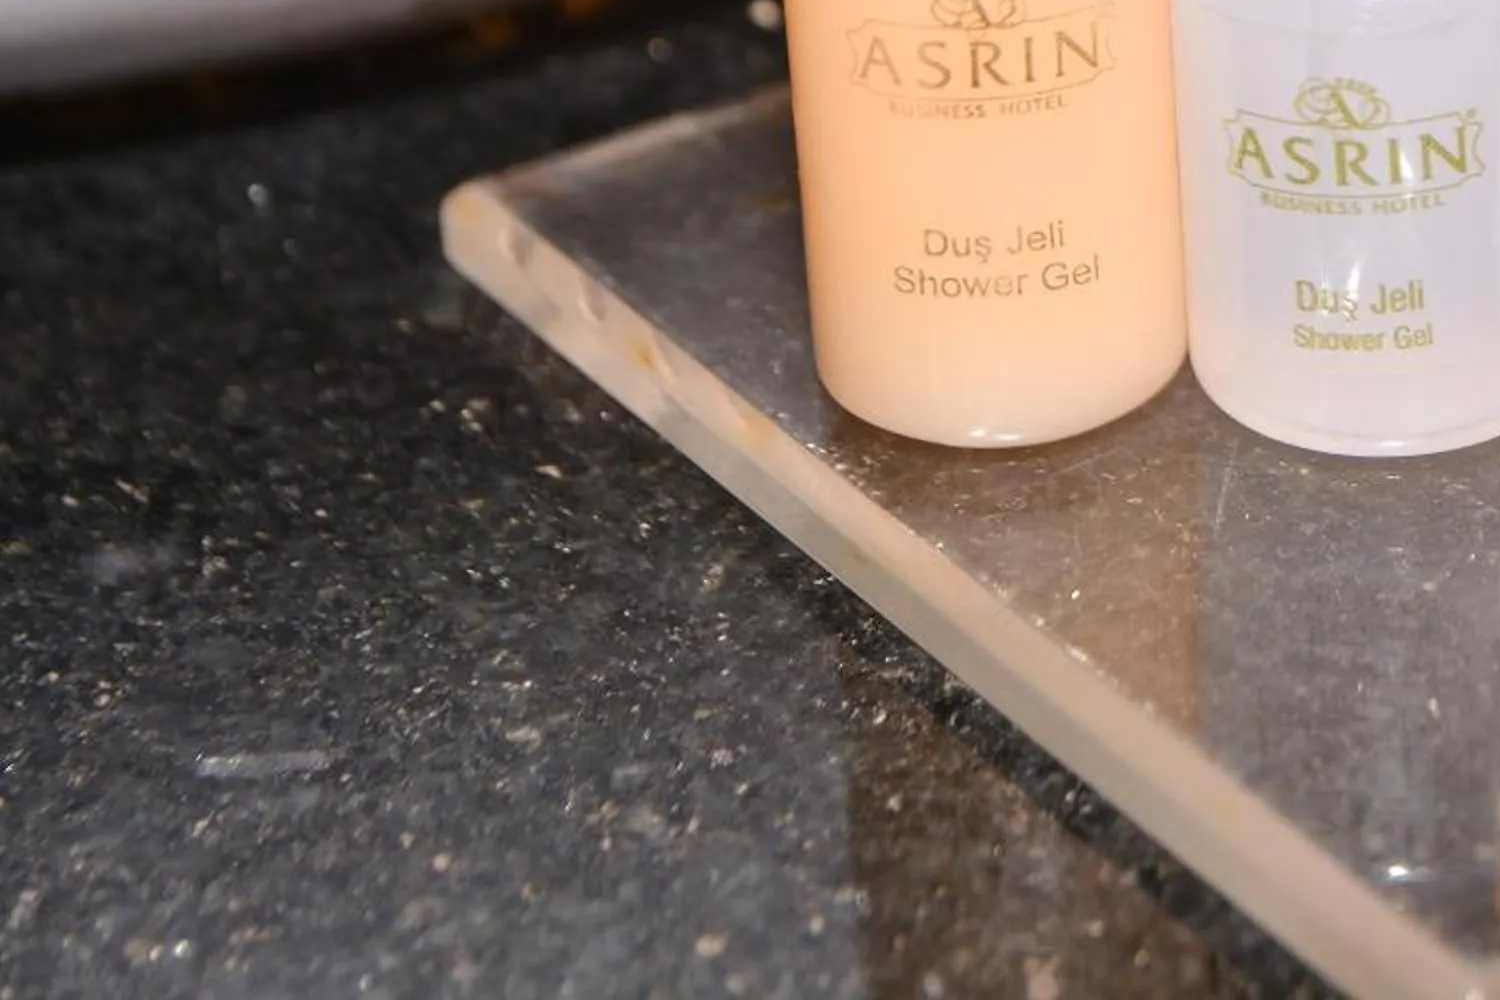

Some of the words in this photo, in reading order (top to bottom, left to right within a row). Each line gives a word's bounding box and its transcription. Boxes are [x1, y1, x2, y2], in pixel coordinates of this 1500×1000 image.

[858, 21, 1099, 90] ASRIN
[889, 99, 987, 120] BUSINESS
[999, 94, 1066, 116] HOTEL
[1233, 126, 1467, 187] ASRIN
[1259, 191, 1362, 216] BUSINESS
[1370, 193, 1446, 214] HOTEL
[923, 228, 992, 264] Duş
[1006, 219, 1065, 256] Jeli
[893, 265, 1028, 298] Shower
[1041, 253, 1101, 292] Gel
[1294, 279, 1360, 322] Duş
[1369, 277, 1424, 314] Jeli
[1292, 323, 1385, 351] Shower
[1392, 322, 1434, 350] Gel
